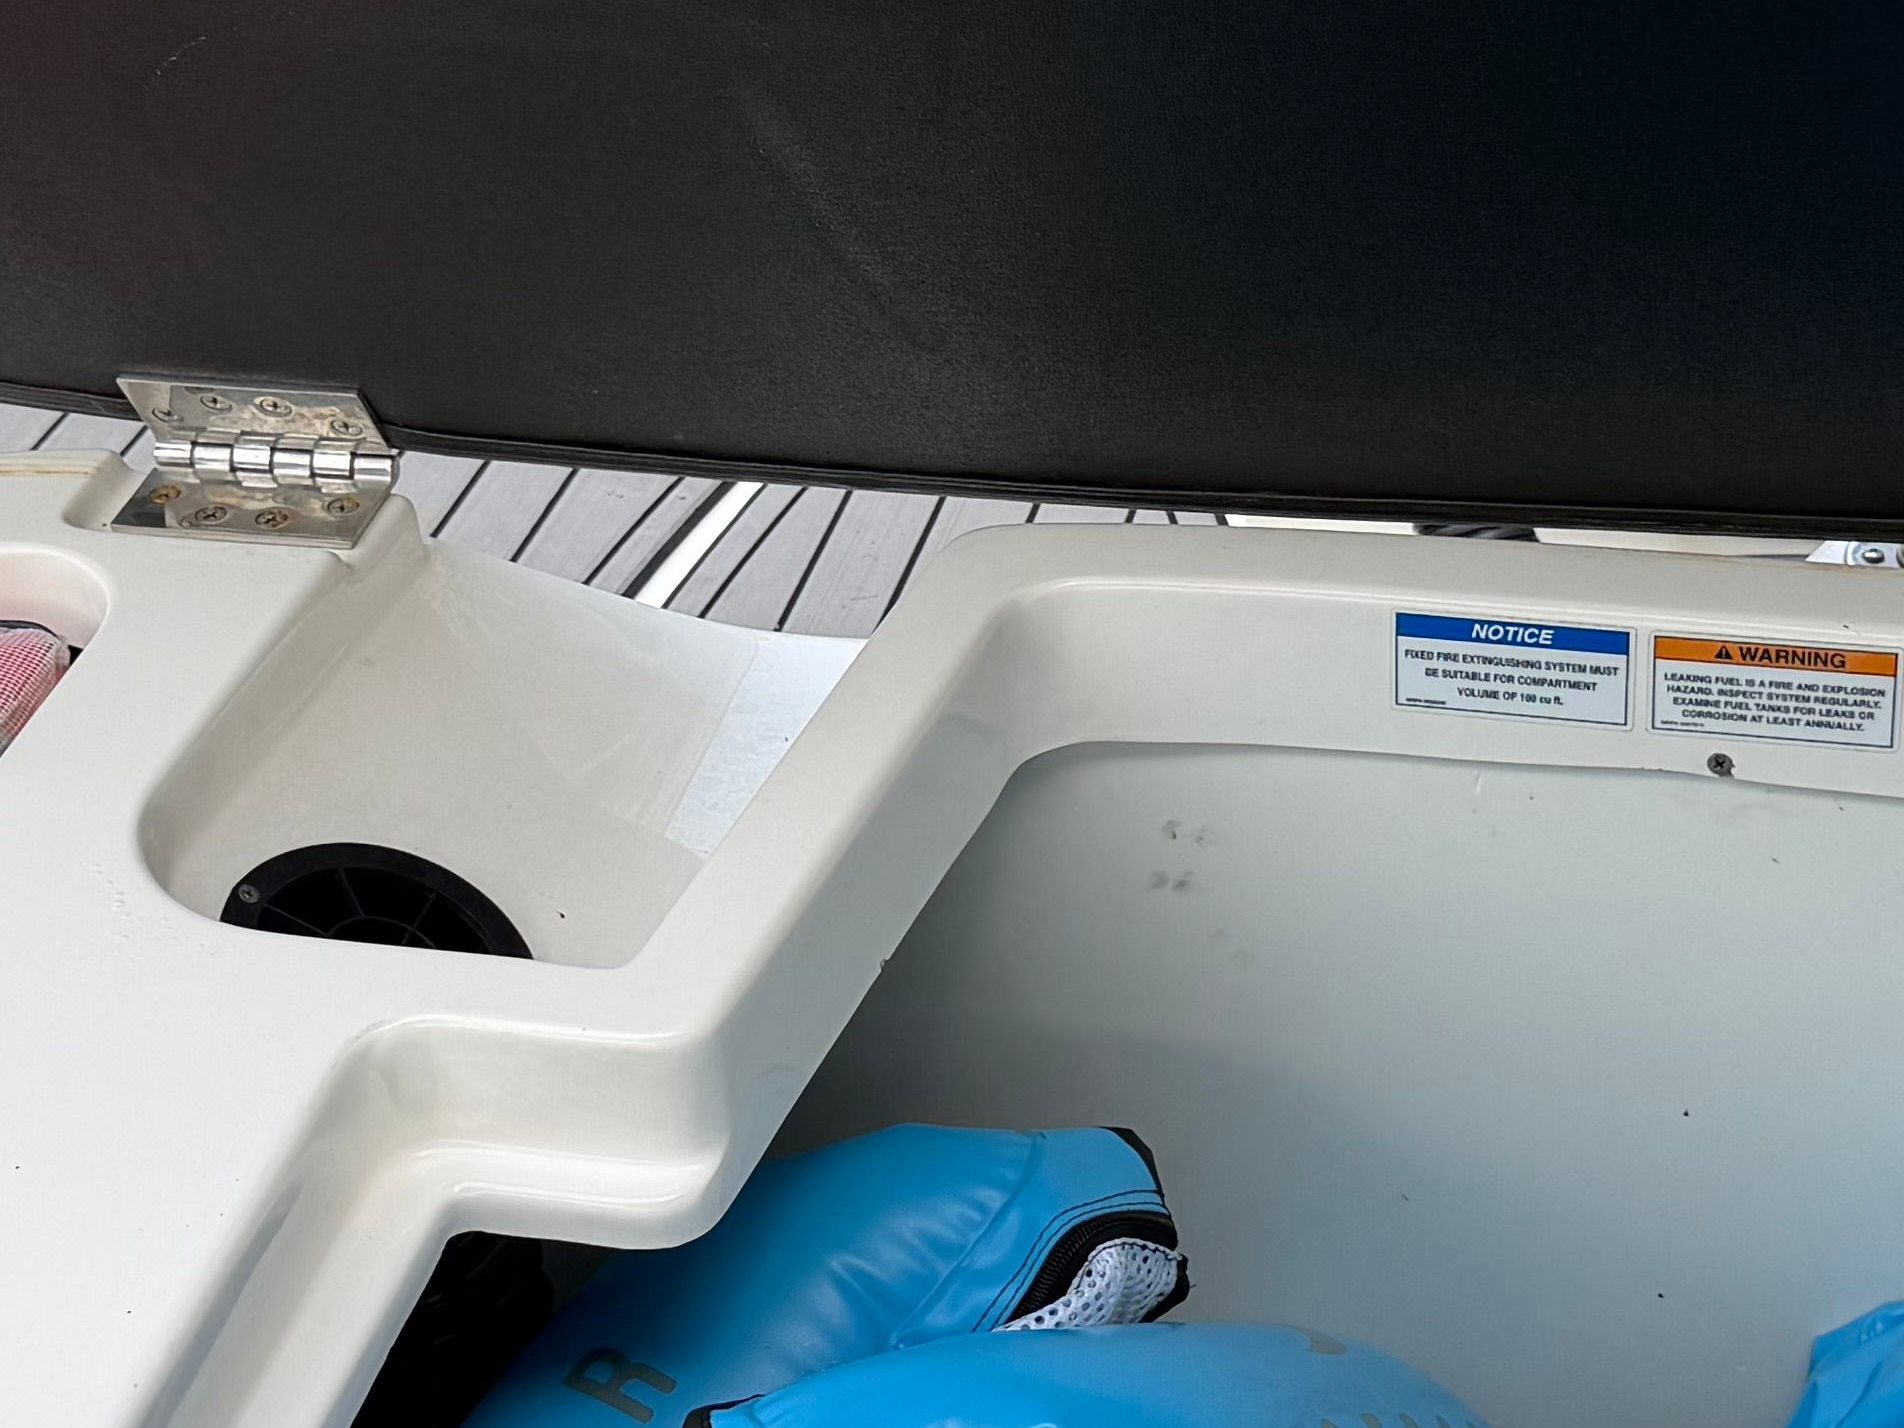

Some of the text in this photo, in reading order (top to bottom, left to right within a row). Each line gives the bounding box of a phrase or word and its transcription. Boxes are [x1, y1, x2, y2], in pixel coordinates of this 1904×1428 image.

[1472, 623, 1555, 645] NOTICE
[1405, 648, 1619, 676] FIXED FIRE EXTINGUISHING SYSTEM MUST
[1739, 646, 1846, 668] WARNING
[1425, 667, 1597, 692] BE SUITABLE FOR COMPARTMENT
[1664, 672, 1885, 697] LEAKING FUEL IS A FIRE AND EXPLOSION
[1457, 687, 1499, 700] VOLUME
[1503, 690, 1516, 701] OF
[1539, 696, 1551, 704] cu
[1667, 684, 1882, 709] HAZARD. INSPECT SYSTEM REGULARLY.
[1673, 696, 1874, 720] EXAMINE FUEL TANKS FOR LEAKS OR
[1682, 709, 1864, 731] CORROSION AT LEAST ANNUALLY.
